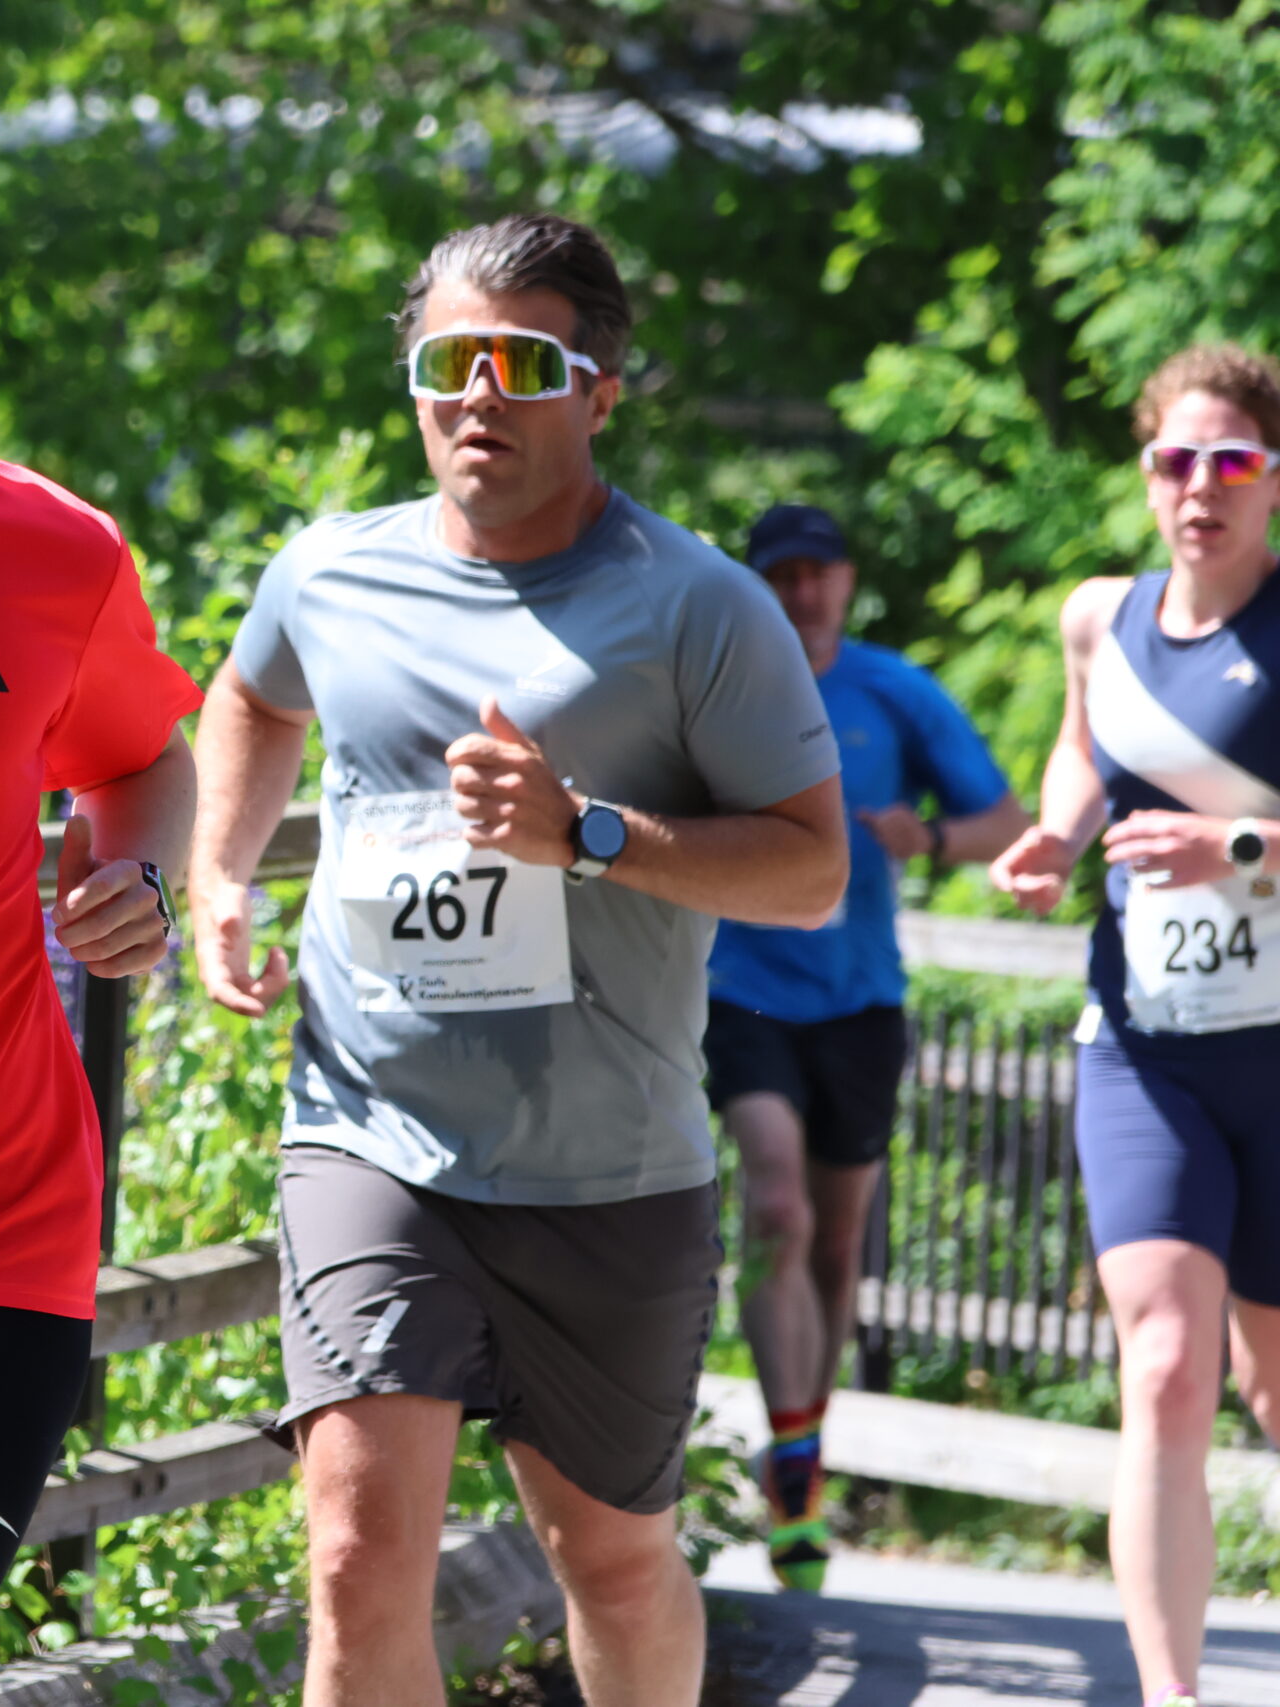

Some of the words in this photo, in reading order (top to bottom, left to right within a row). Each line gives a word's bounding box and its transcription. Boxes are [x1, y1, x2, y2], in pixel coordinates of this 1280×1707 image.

[363, 799, 455, 818] SENTRUMSGATE
[387, 867, 508, 942] 267
[1163, 916, 1259, 973] 234
